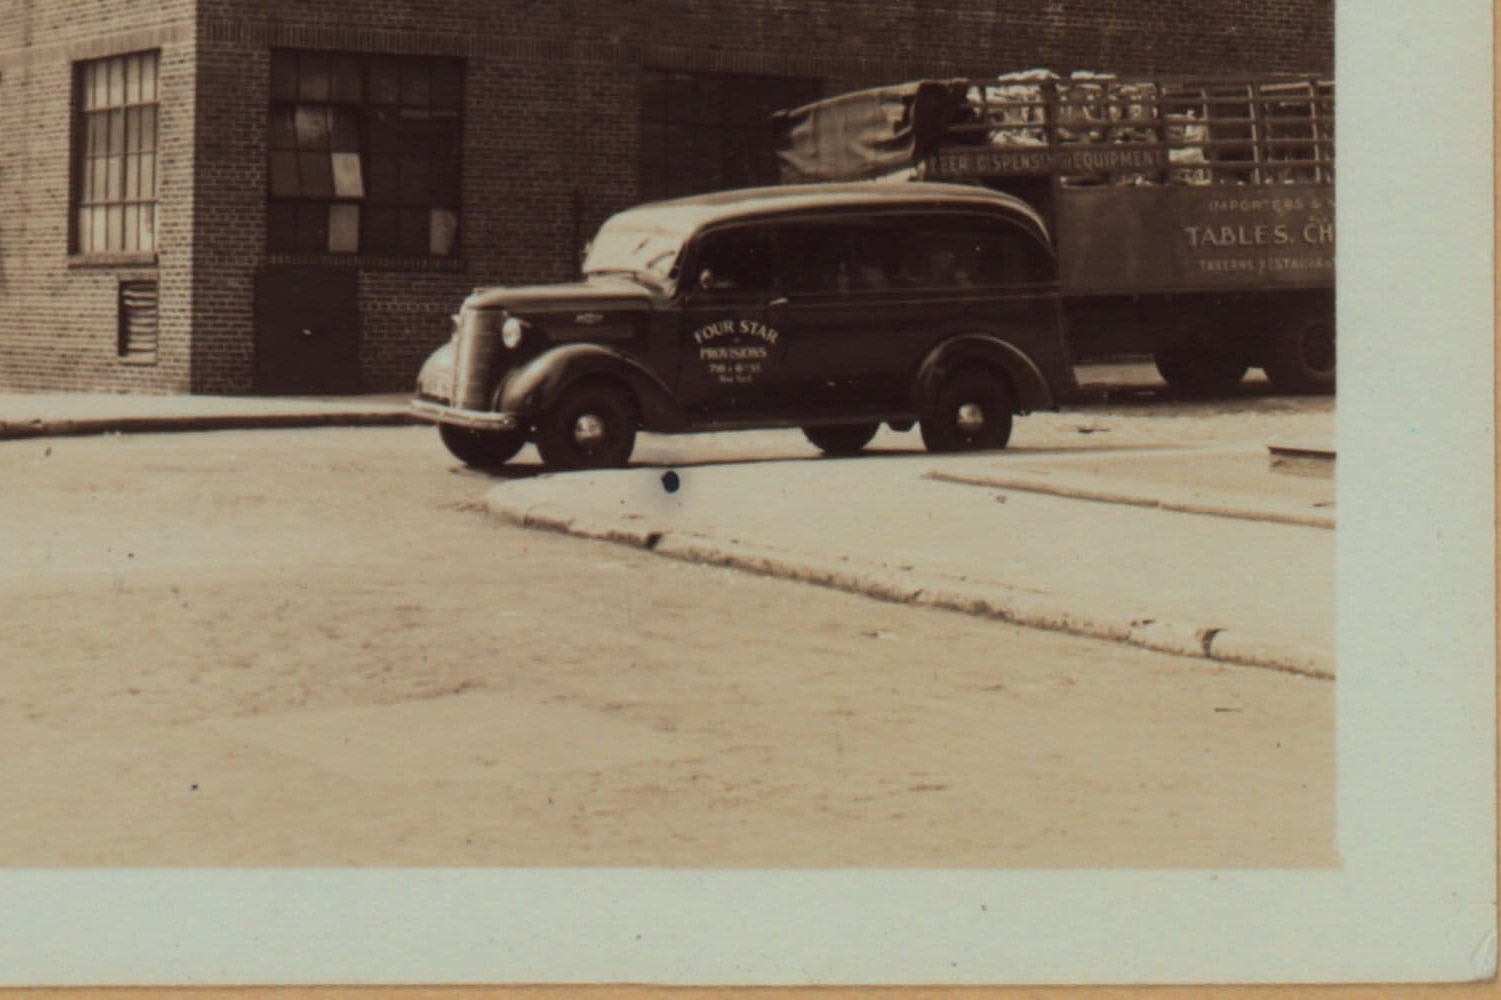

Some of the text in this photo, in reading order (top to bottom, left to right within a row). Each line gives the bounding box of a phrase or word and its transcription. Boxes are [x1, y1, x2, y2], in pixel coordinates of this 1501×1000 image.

[1072, 150, 1161, 170] EQUIPMENT
[693, 319, 780, 345] FOUR STAR
[699, 346, 768, 361] PROVISIONS
